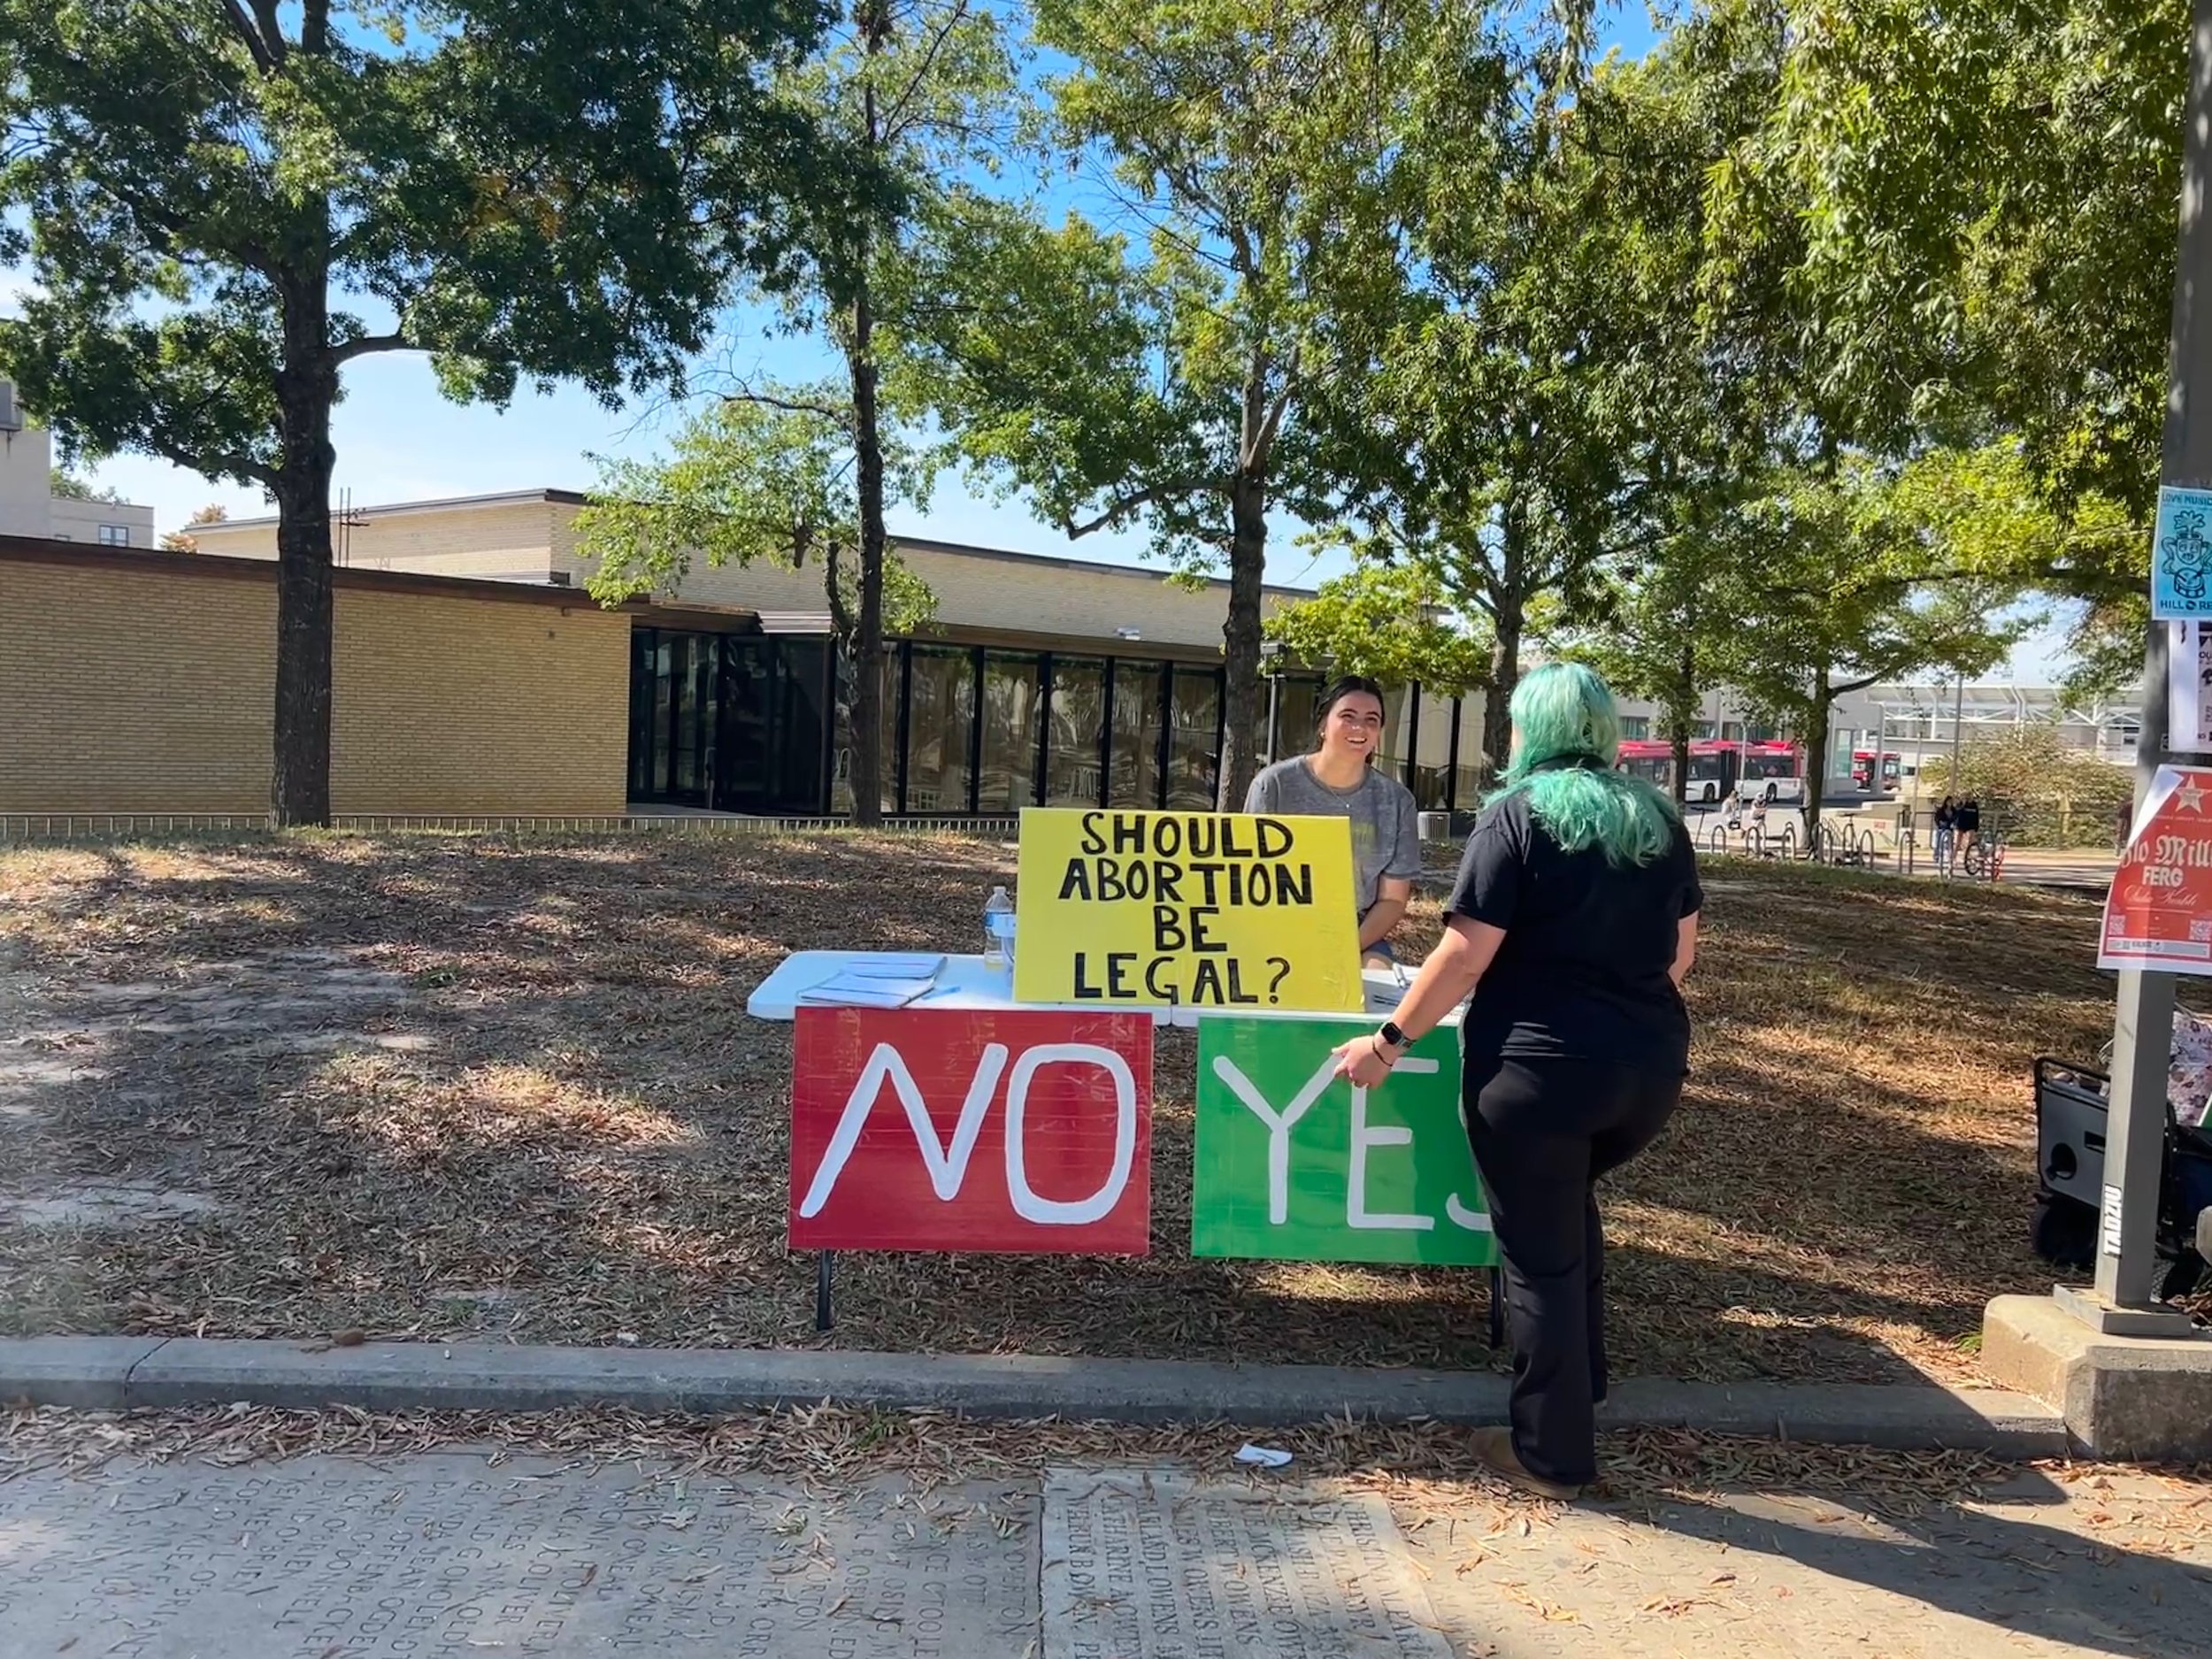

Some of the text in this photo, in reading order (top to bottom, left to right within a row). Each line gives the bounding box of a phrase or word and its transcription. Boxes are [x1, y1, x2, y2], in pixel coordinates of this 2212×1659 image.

[2160, 600, 2185, 610] HILL
[1081, 811, 1294, 858] SHOULD
[1058, 857, 1313, 906] ABORTION
[2142, 865, 2184, 887] FERG
[1155, 905, 1228, 952] BE
[1073, 952, 1291, 1006] LEGAL?
[799, 1041, 1136, 1225] NO
[2102, 1185, 2123, 1256] TADZIU
[403, 1480, 457, 1525] DAVID
[1203, 1499, 1240, 1558] ROBERT
[1223, 1579, 1263, 1646] OWENS
[1147, 1577, 1179, 1635] OWENS
